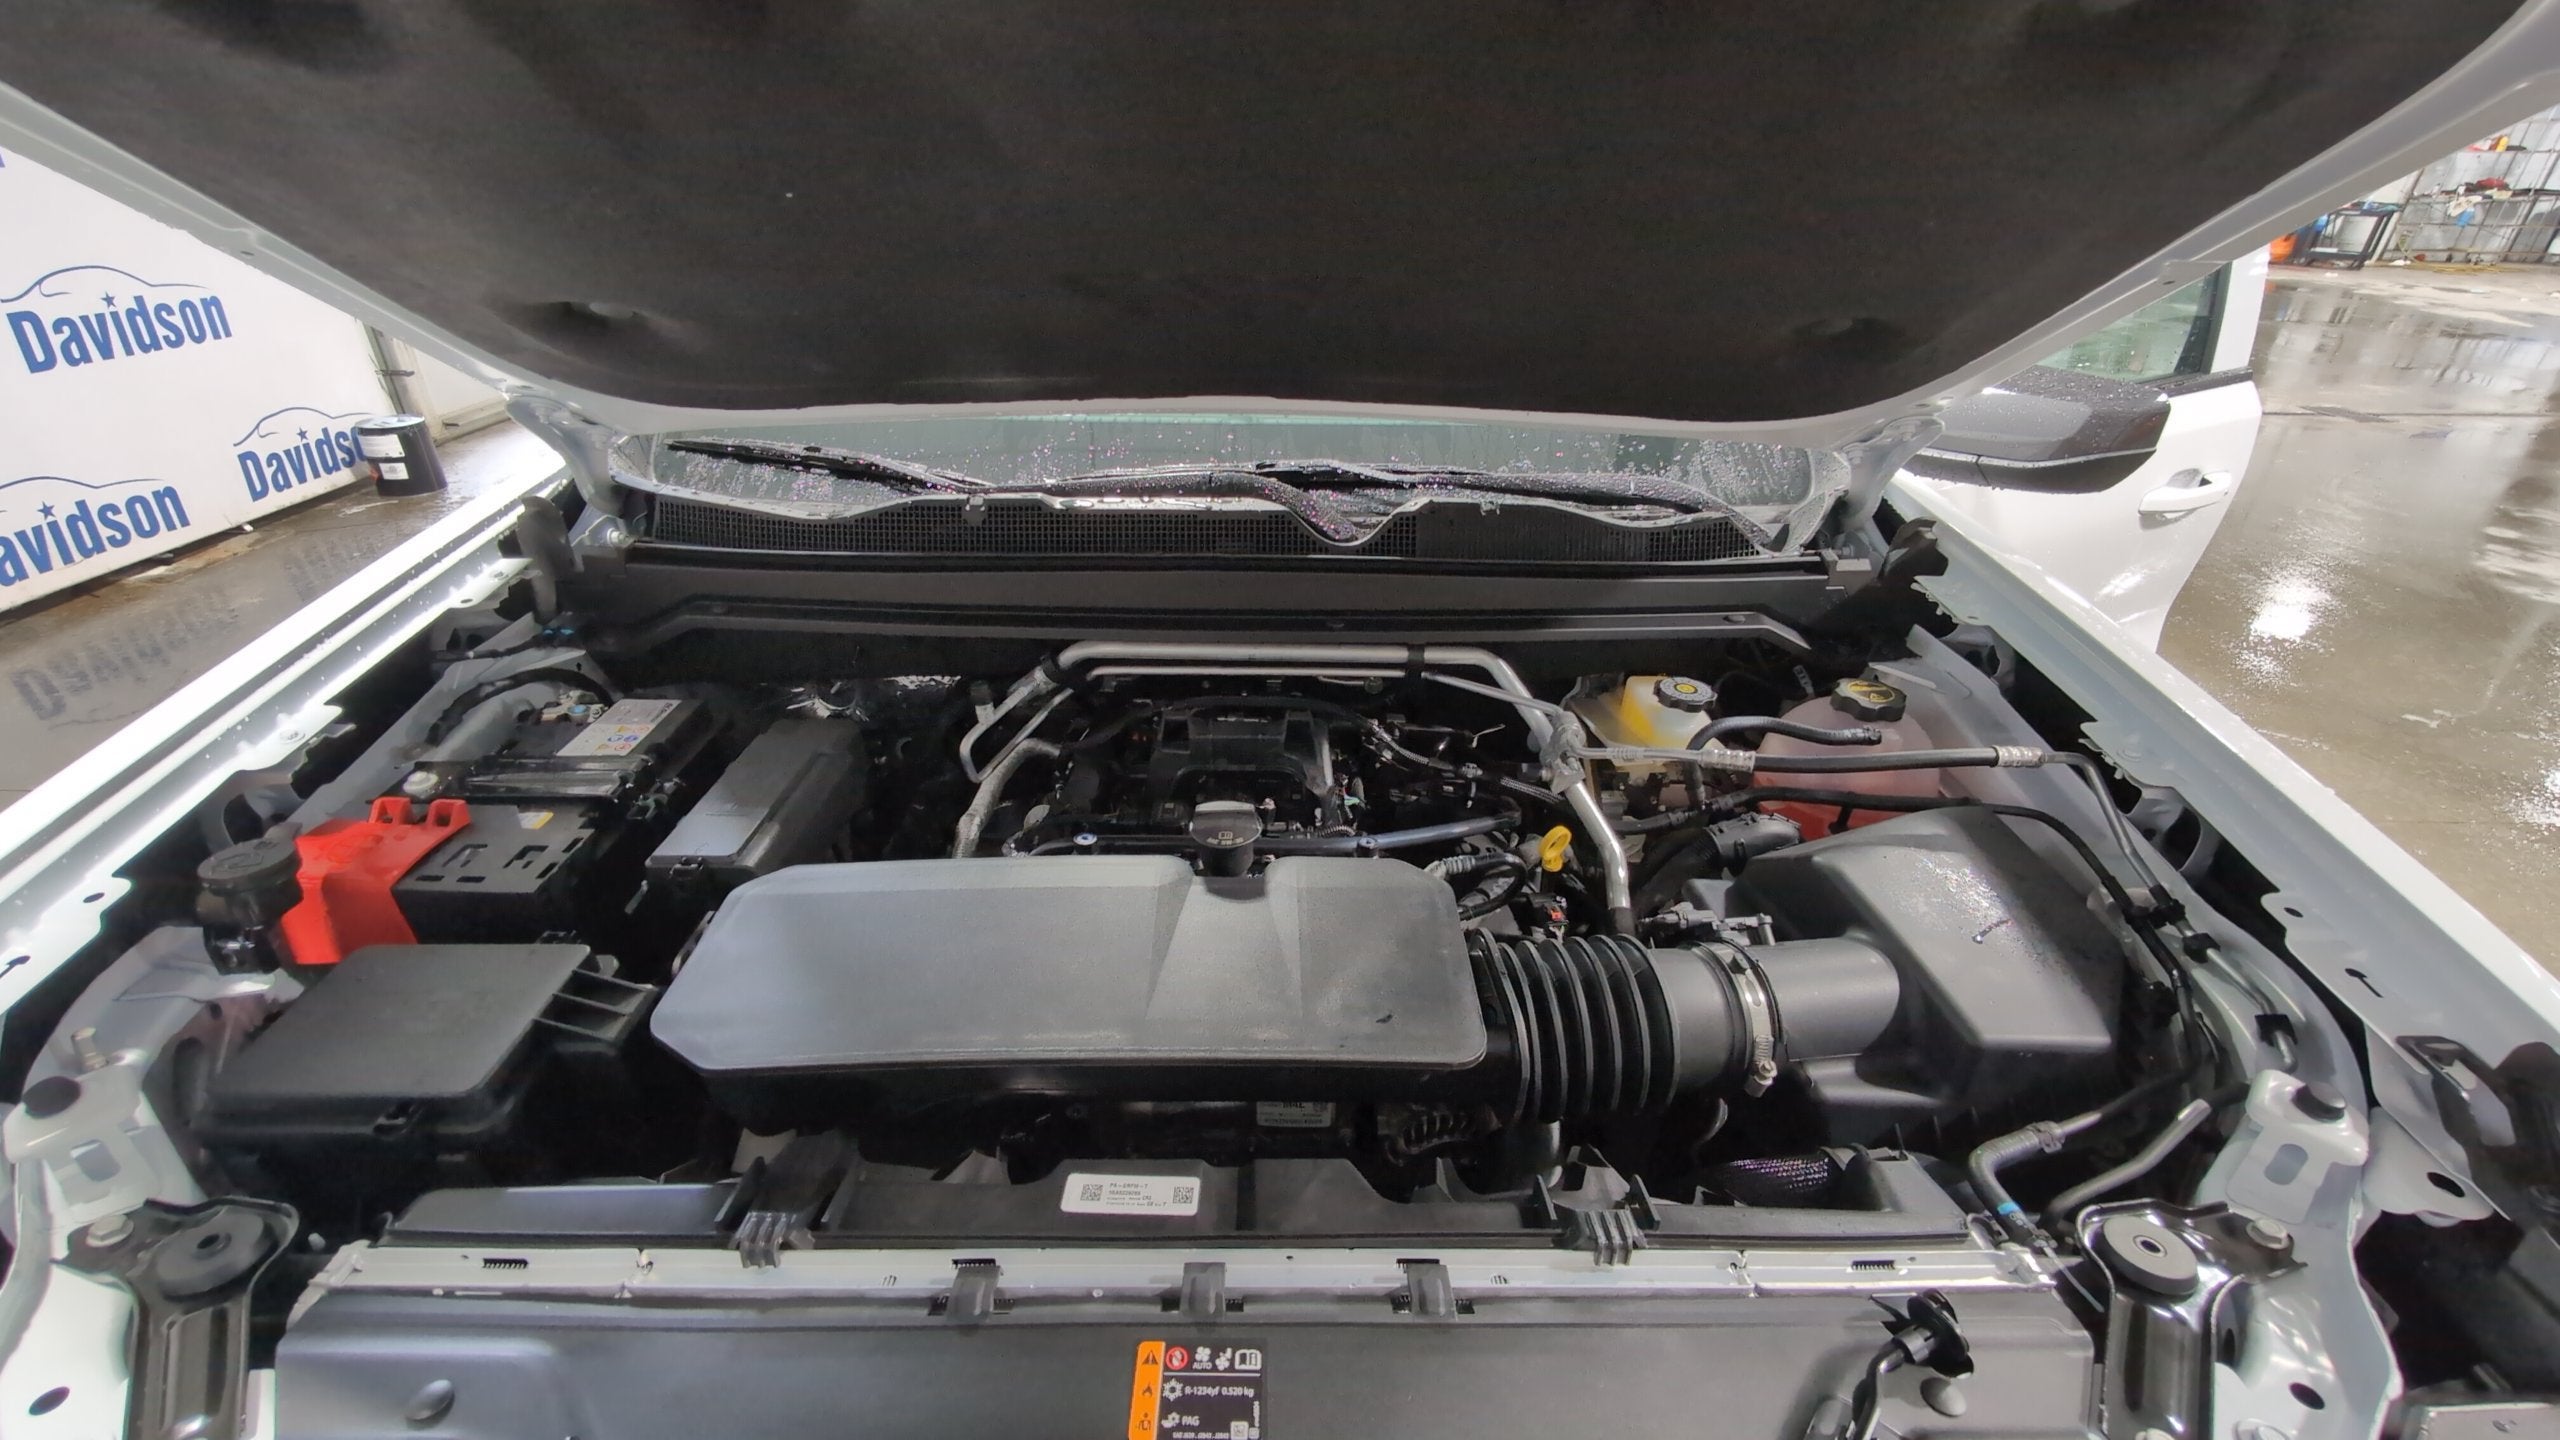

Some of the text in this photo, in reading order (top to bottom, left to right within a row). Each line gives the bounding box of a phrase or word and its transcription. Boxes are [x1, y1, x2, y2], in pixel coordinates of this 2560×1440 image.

[6, 292, 233, 374] Davidson
[237, 427, 368, 502] Davids
[0, 485, 191, 587] avidson
[1192, 1362, 1213, 1370] AUTO
[1184, 1385, 1255, 1398] R-1234yf 0.520 kg
[1182, 1415, 1200, 1426] PAG
